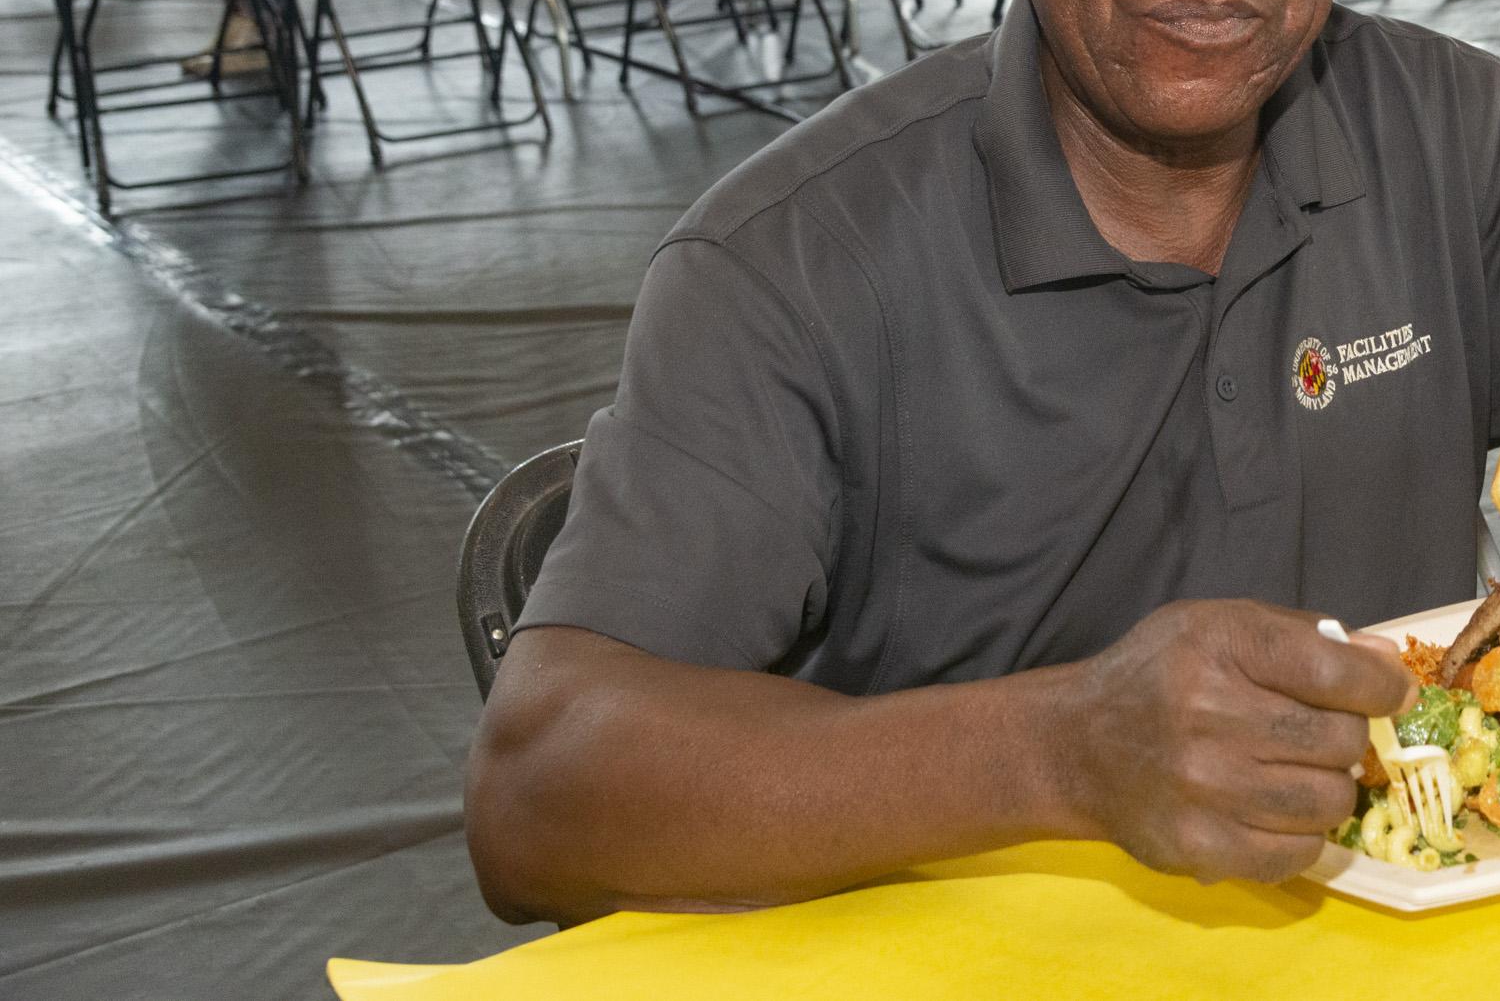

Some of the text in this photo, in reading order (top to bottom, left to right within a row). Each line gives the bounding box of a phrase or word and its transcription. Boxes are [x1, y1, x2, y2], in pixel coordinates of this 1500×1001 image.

[1336, 323, 1413, 363] FACILITIES
[1341, 335, 1432, 385] MANAGEMENT
[1326, 363, 1339, 377] 56
[1295, 380, 1336, 411] MARYLAND
